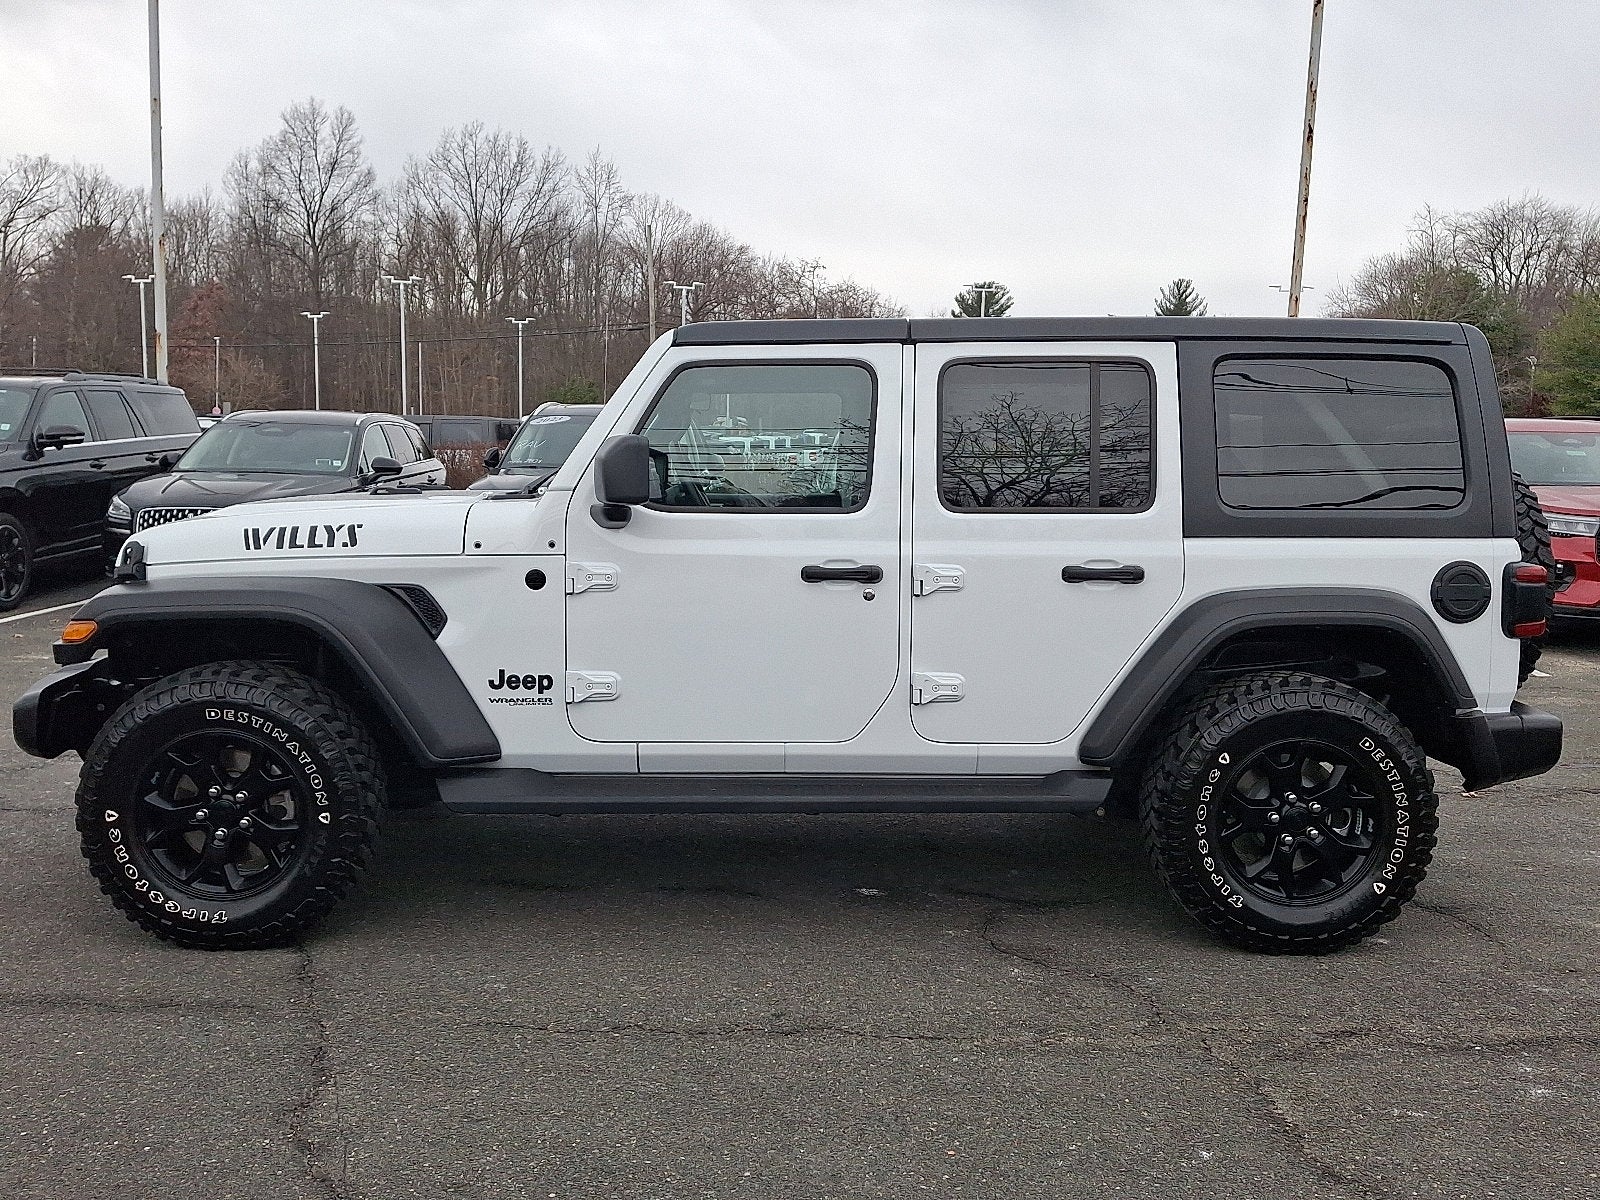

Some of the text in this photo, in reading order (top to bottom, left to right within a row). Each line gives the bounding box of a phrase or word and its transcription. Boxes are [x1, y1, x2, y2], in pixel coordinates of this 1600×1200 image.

[243, 523, 364, 550] WILLYS
[488, 668, 554, 695] Jeep
[205, 708, 329, 806] DESTINATION
[1194, 768, 1244, 908] Firestone
[1358, 736, 1410, 880] DESTINATION
[108, 827, 229, 924] Firestone
